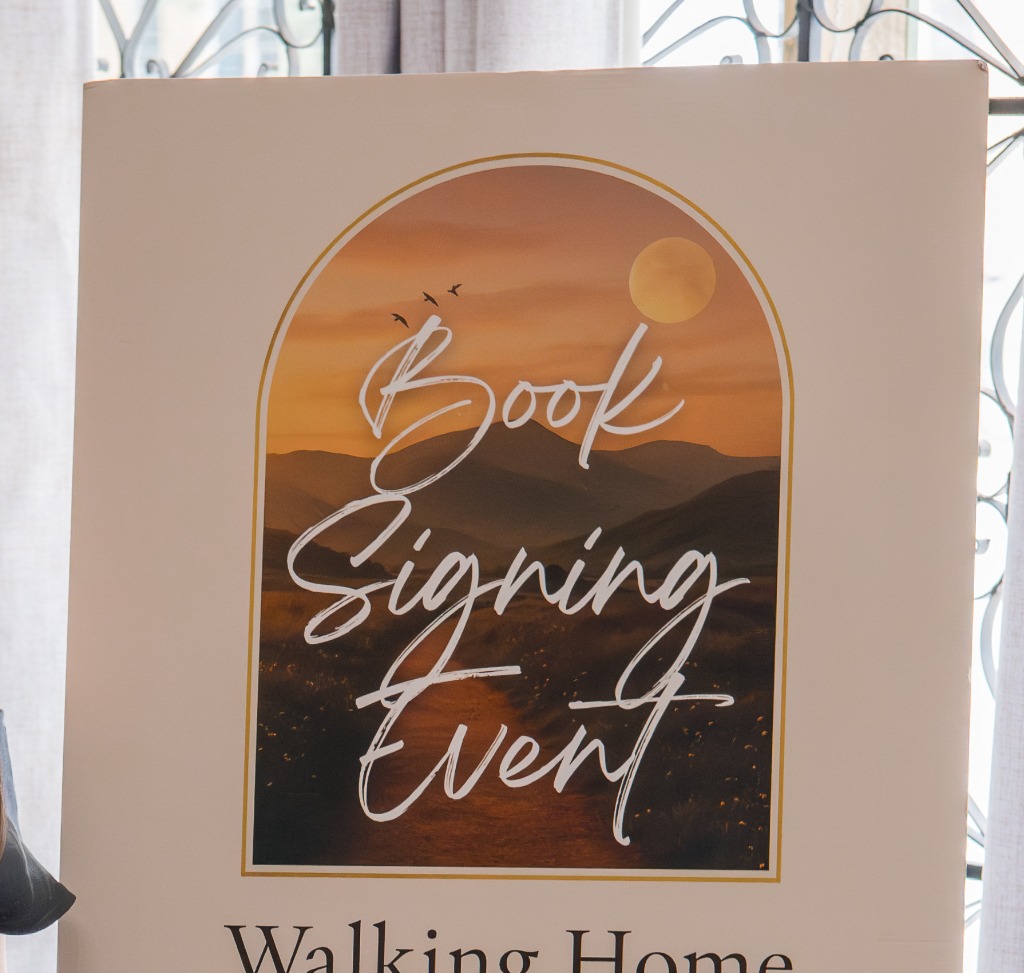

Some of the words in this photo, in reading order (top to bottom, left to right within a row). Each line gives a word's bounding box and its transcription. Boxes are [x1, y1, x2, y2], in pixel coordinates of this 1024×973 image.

[358, 315, 685, 496] Book
[287, 493, 751, 710] Signing
[355, 665, 735, 846] Event
